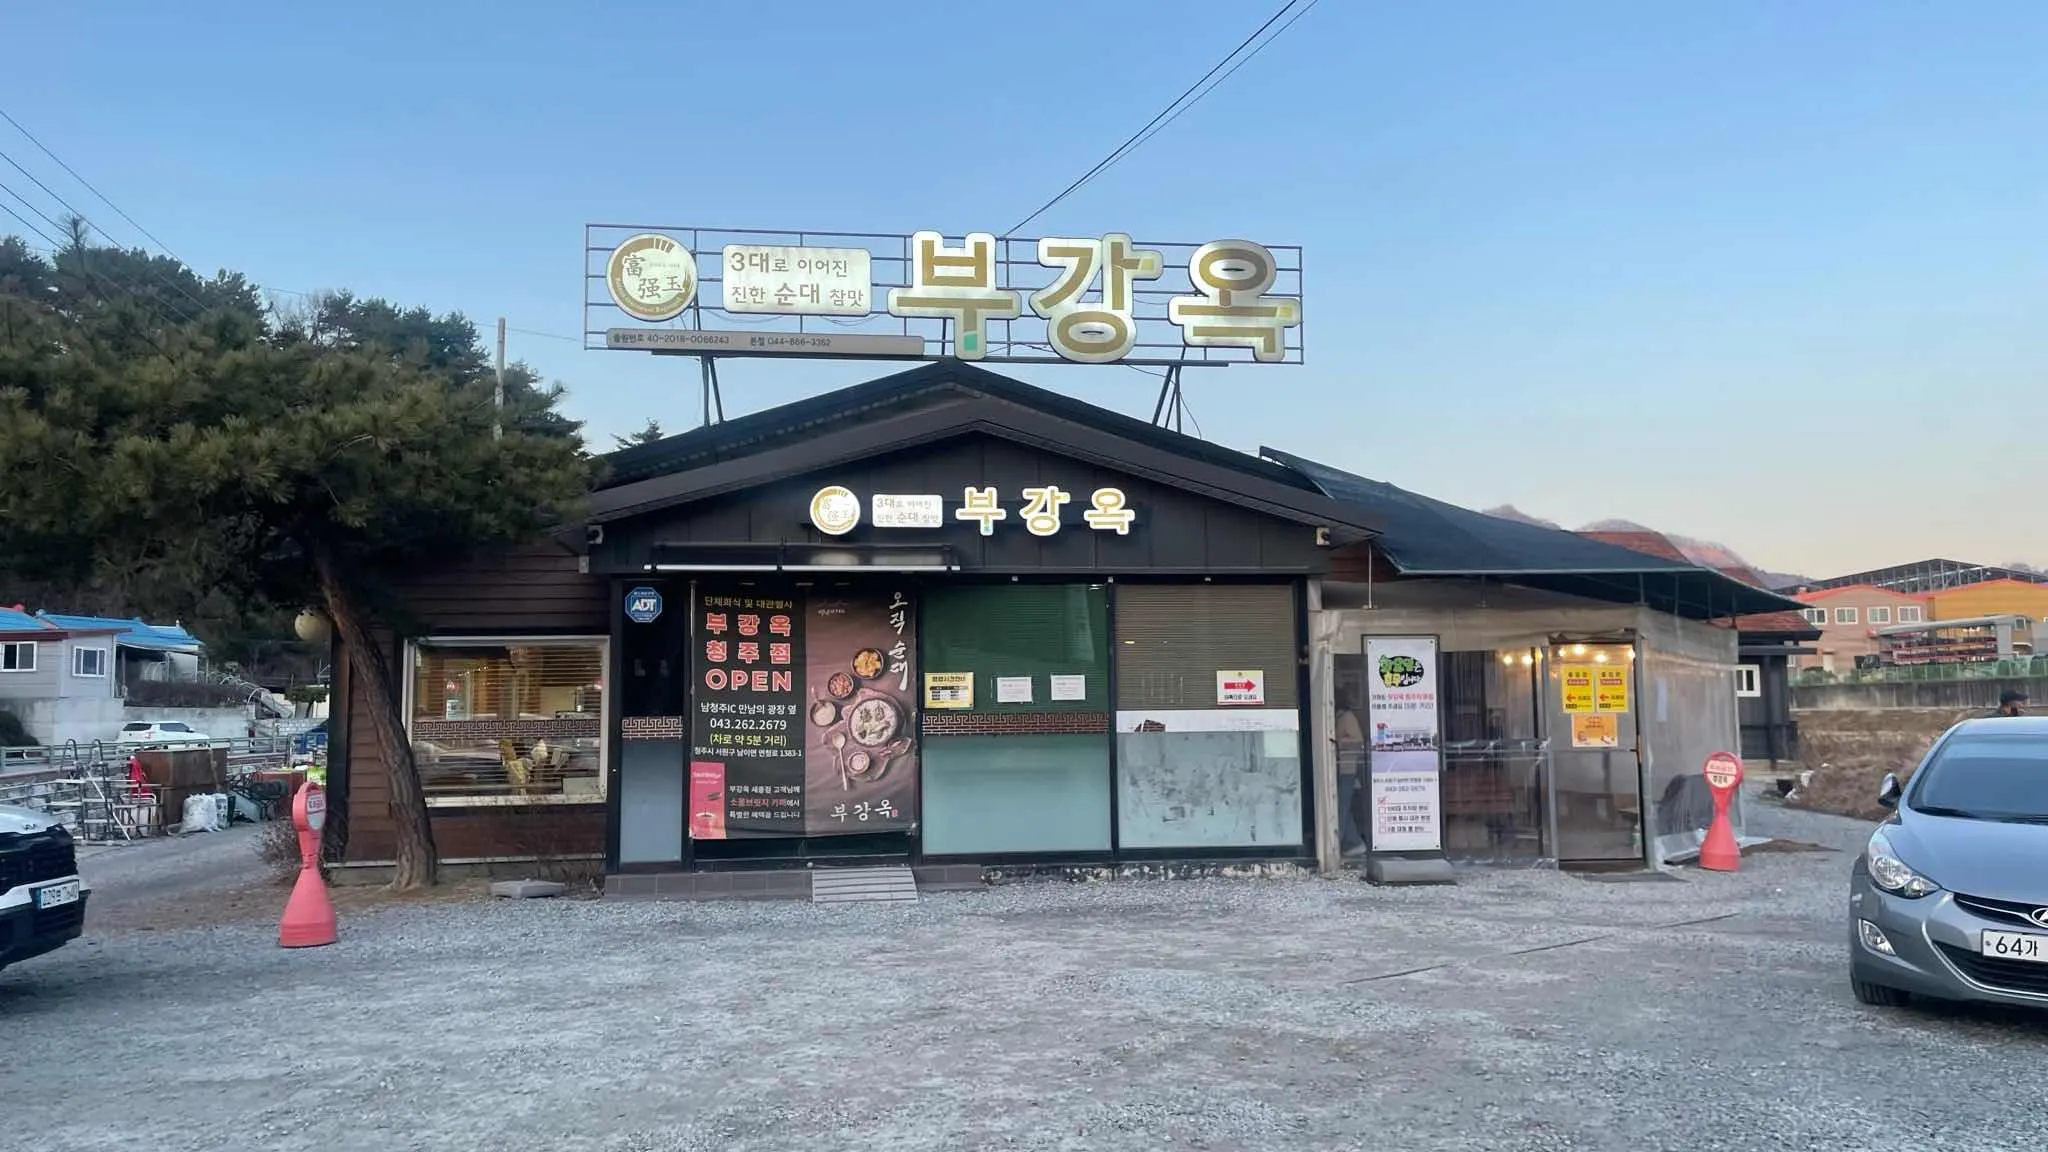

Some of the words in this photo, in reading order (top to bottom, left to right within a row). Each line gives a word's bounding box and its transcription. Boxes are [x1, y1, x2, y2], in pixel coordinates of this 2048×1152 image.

[730, 252, 789, 273] 3대로
[797, 260, 848, 278] 이어진
[731, 286, 766, 305] 진한
[774, 283, 821, 306] 순대
[829, 288, 865, 307] 참맛
[888, 230, 1300, 363] 부강옥
[956, 486, 1136, 536] 부강옥
[631, 598, 657, 612] ADT
[706, 612, 791, 637] 부강옥
[706, 640, 791, 665] 청주점
[705, 668, 792, 692] OPEN
[700, 702, 737, 714] 남청주IC
[738, 704, 765, 715] 만남의
[767, 704, 785, 715] 광장
[787, 704, 797, 715] 옆
[709, 718, 787, 730] 043.262.2679
[709, 733, 733, 745] (차로
[734, 734, 745, 745] 약
[746, 735, 762, 746] 5분
[764, 735, 787, 747] 거리)
[830, 799, 892, 823] 부강옥
[1995, 935, 2038, 957] 64가
